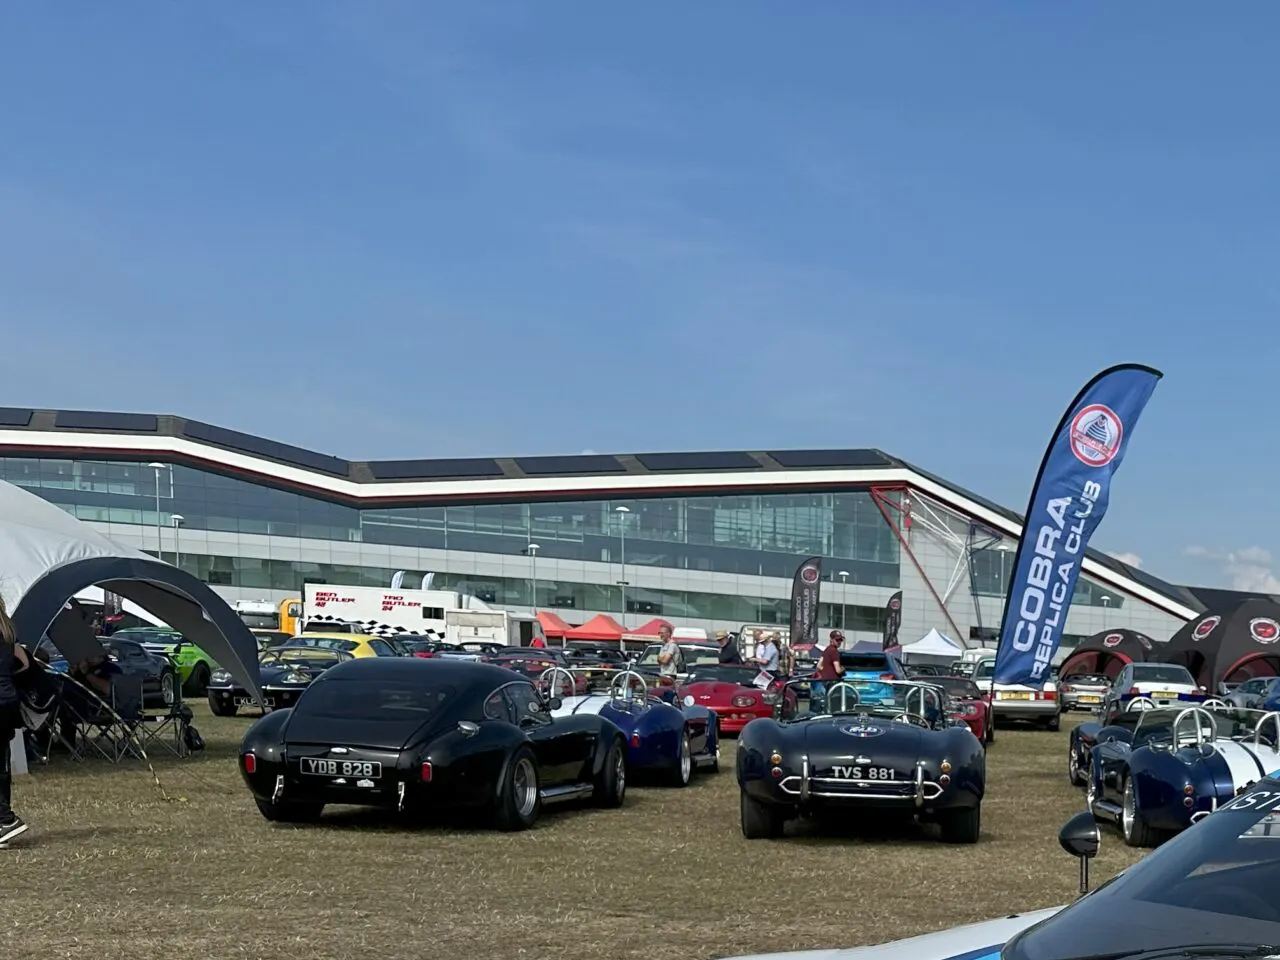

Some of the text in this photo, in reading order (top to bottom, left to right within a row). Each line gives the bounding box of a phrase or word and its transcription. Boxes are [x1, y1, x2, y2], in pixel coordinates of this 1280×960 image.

[1013, 496, 1072, 652] COBRA
[1030, 562, 1074, 679] REPLICA
[1065, 480, 1101, 555] CLUB
[309, 759, 373, 777] YDB 828
[832, 766, 895, 780] TVS 881
